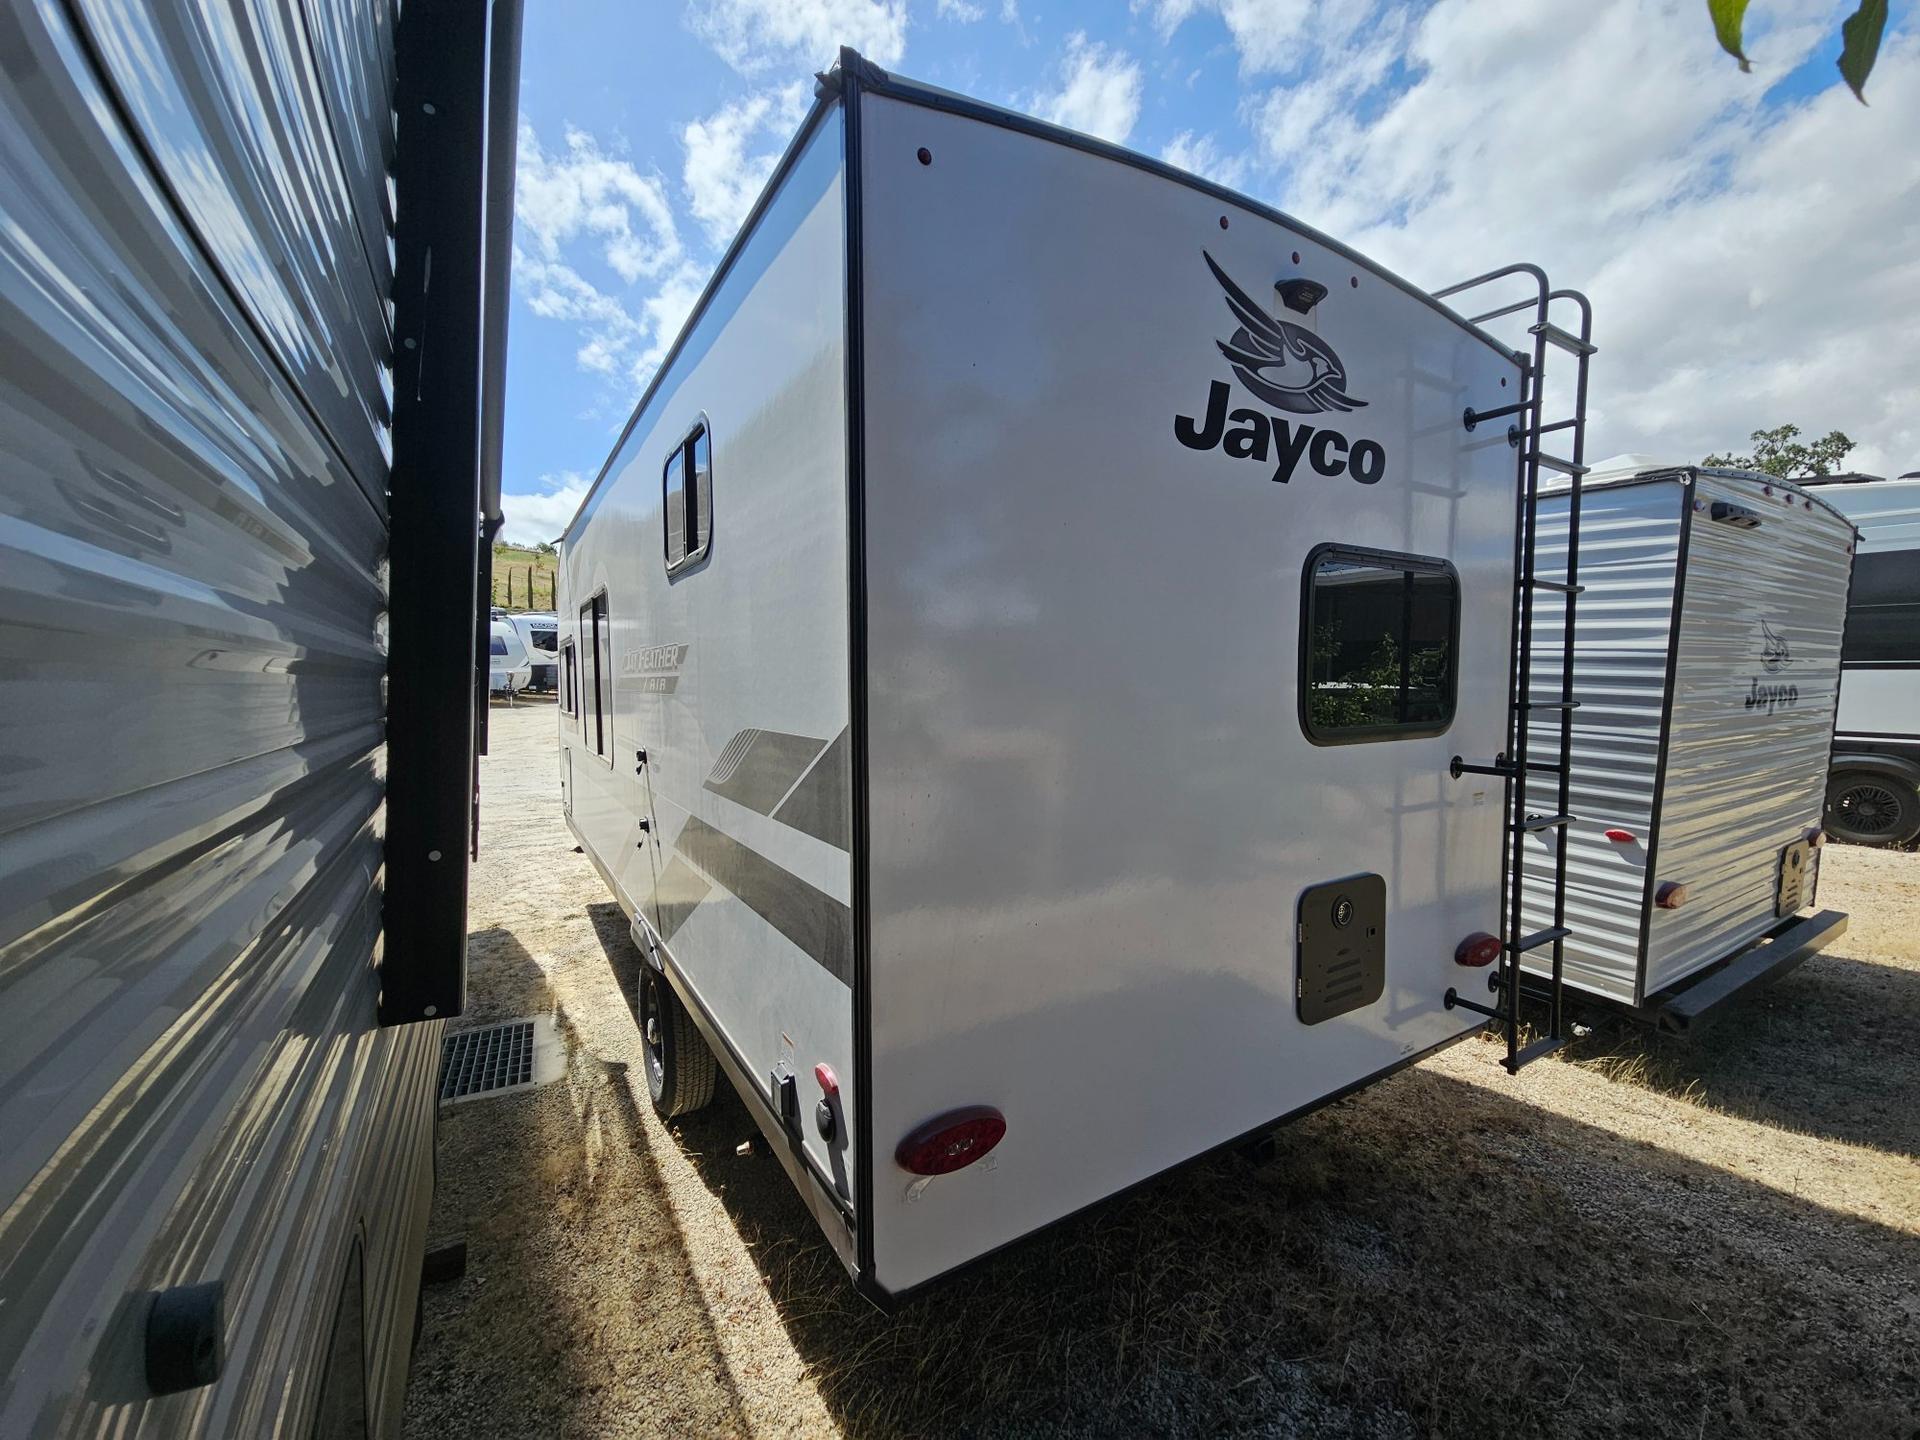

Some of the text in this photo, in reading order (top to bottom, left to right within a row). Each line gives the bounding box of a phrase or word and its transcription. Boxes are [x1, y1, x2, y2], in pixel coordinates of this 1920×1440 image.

[1174, 379, 1386, 485] Jayco
[649, 678, 667, 691] AIR
[1745, 676, 1798, 716] Jayco
